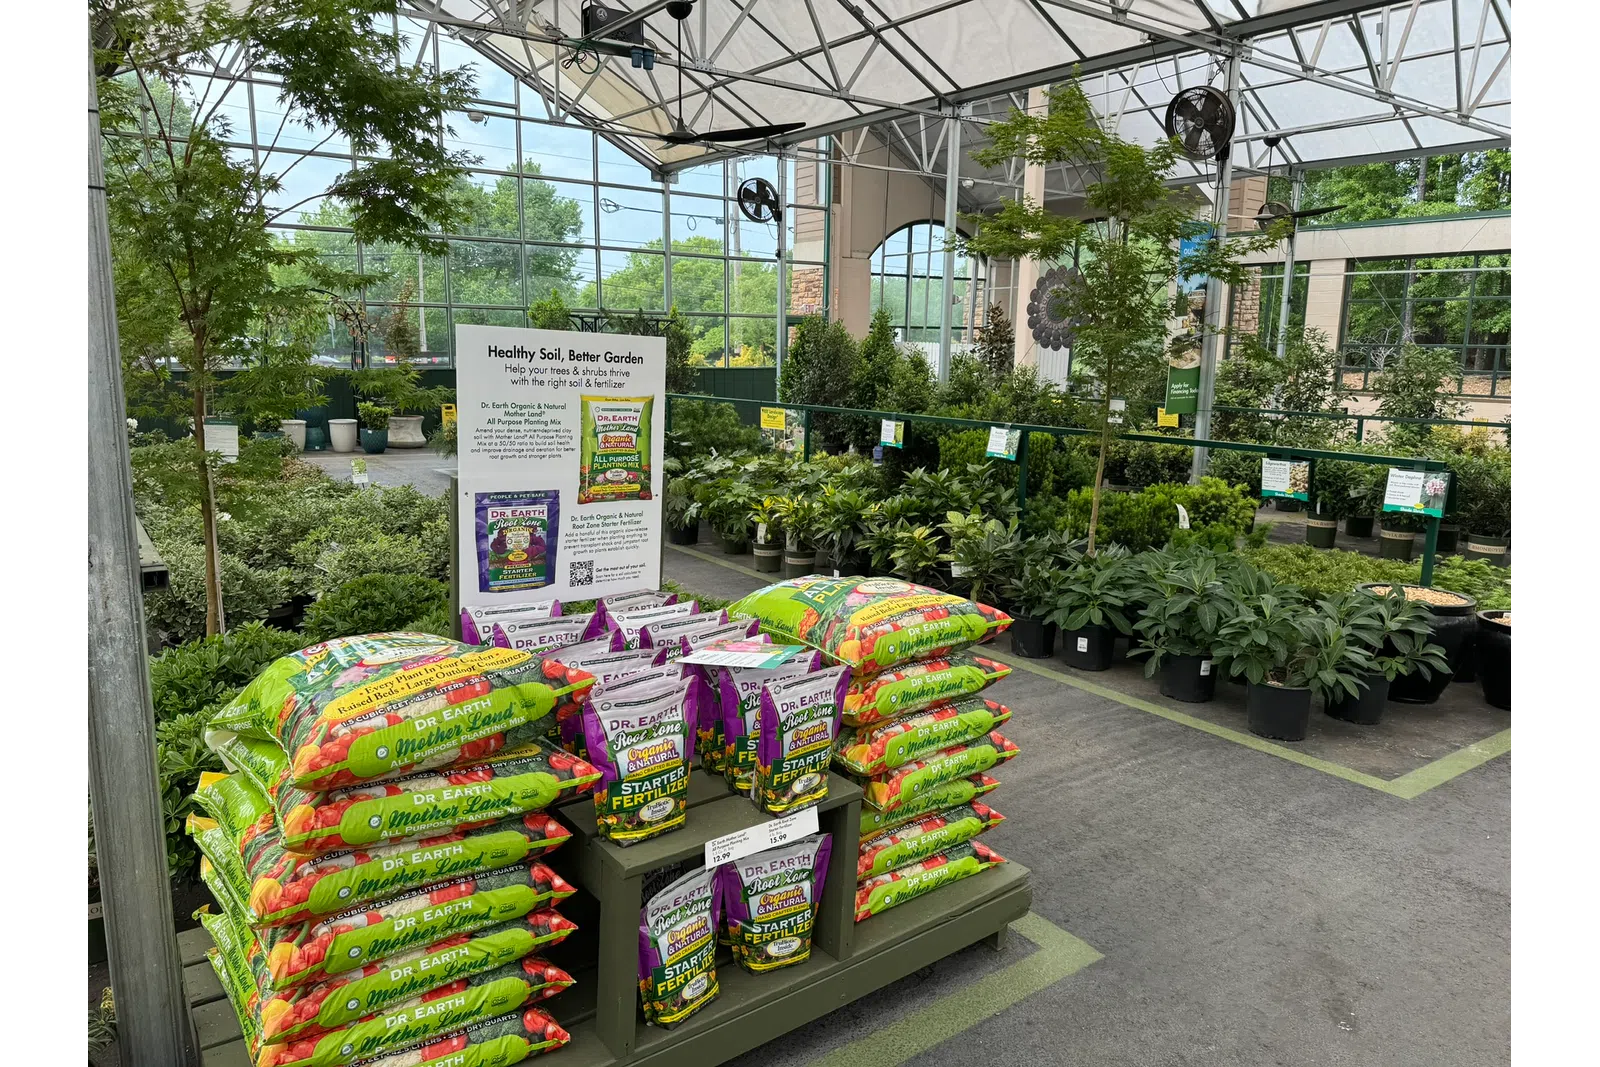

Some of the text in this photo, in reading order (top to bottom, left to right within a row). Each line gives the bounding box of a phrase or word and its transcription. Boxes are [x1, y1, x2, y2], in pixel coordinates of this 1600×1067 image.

[488, 345, 643, 364] Healthy Soil, Better Garden
[505, 364, 526, 375] Help
[528, 367, 548, 375] your
[573, 367, 579, 375] &
[582, 367, 607, 377] shrubs
[610, 368, 630, 378] thrive
[511, 377, 625, 389] with the right soil & fertilizer
[596, 424, 638, 432] Mother Land
[494, 518, 541, 529] Root Zone
[338, 652, 526, 714] Raised Beds Large Outdoor Containers
[365, 681, 394, 694] Every
[396, 670, 422, 684] Plant
[436, 660, 459, 670] Your
[926, 672, 952, 683] EARTH
[356, 709, 385, 722] CUBIC
[386, 700, 409, 712] FEET
[413, 692, 434, 702] 42.5
[435, 682, 464, 695] LITERS
[504, 663, 536, 675] QUARTS
[900, 677, 963, 704] Mother Land
[442, 699, 491, 720] EARTH
[610, 705, 678, 731] DR. EARTH
[396, 702, 515, 758] Mother Land
[613, 721, 681, 750] Root Zone
[391, 716, 526, 768] ALL PURPOSE PLANTING MIX
[628, 738, 674, 760] Organic
[637, 750, 678, 768] NATURAL
[621, 766, 684, 794] STARTER
[443, 784, 493, 801] EARTH
[388, 792, 514, 829] Mother Land
[770, 834, 787, 844] 15.99
[713, 852, 730, 863] 12.99
[745, 854, 811, 878] DR. EARTH
[748, 868, 809, 895] Root Zone
[761, 886, 802, 905] Organic
[766, 896, 806, 911] NATURAL
[752, 909, 811, 932] STARTER
